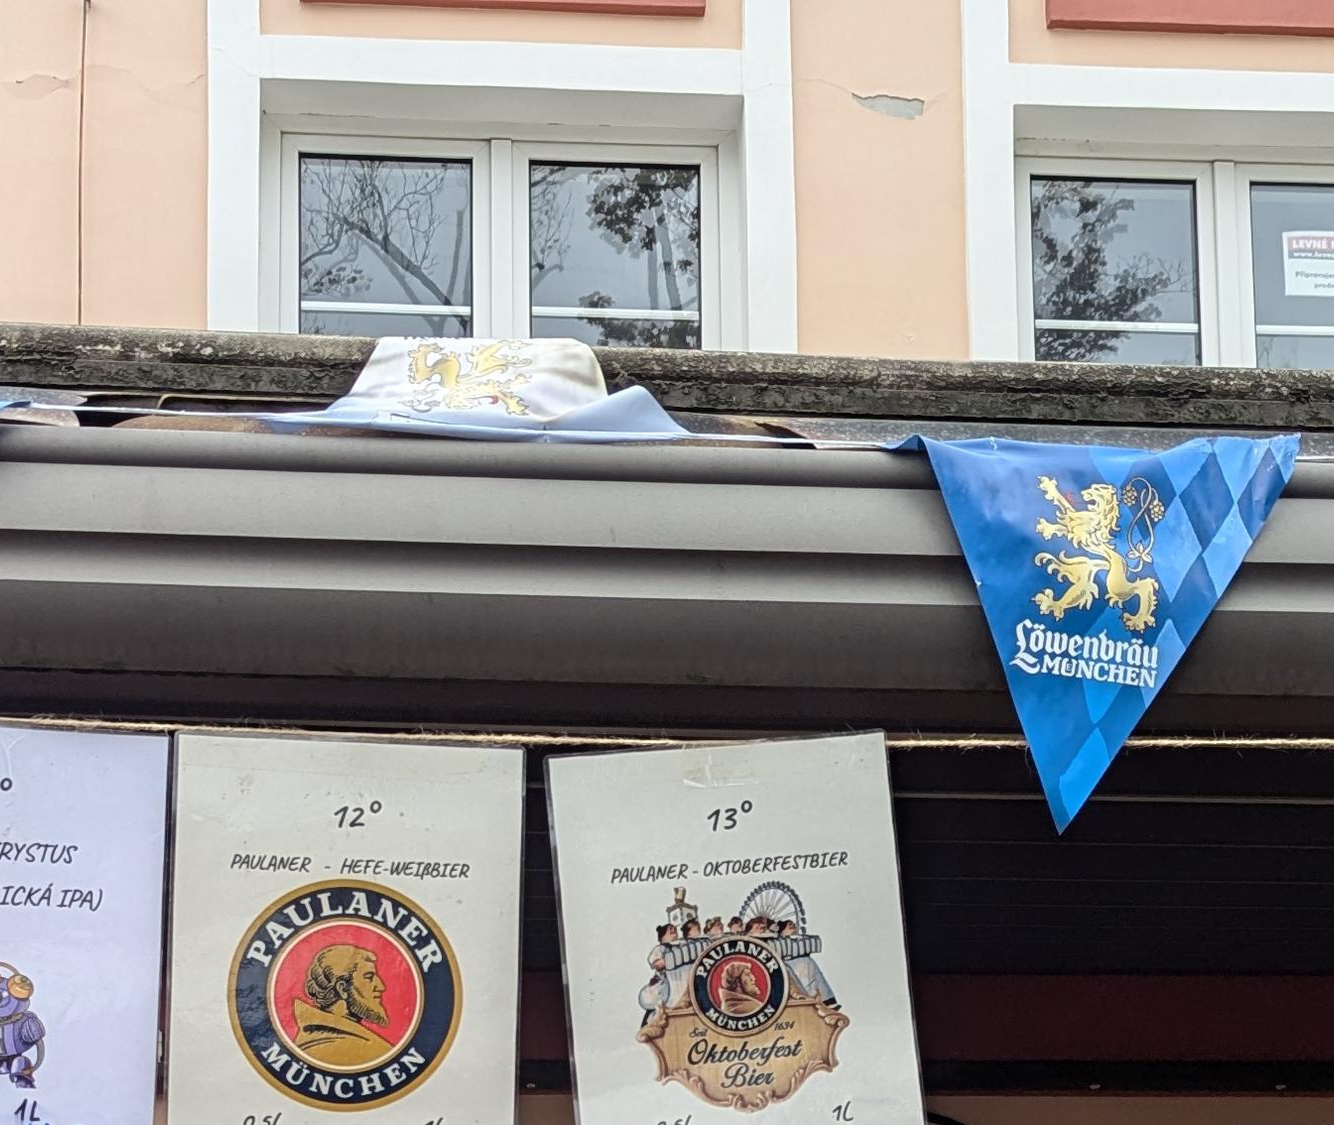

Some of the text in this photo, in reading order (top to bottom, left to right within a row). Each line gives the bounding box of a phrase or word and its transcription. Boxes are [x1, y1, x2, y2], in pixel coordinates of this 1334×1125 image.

[1010, 618, 1160, 676] Löwenbräu
[229, 853, 313, 874] PAULANER
[610, 862, 689, 885] PAULANER
[702, 851, 849, 878] OKTOBERFESTBIER
[55, 886, 104, 912] IPA)
[245, 890, 446, 974] PAULANER
[695, 938, 780, 978] PAULANER
[705, 1006, 777, 1031] MÜNCHEN
[773, 1020, 796, 1032] 1634
[686, 1036, 804, 1067] Oktoberfest
[259, 1041, 427, 1099] MÜNCHEN
[720, 1063, 775, 1089] Bier
